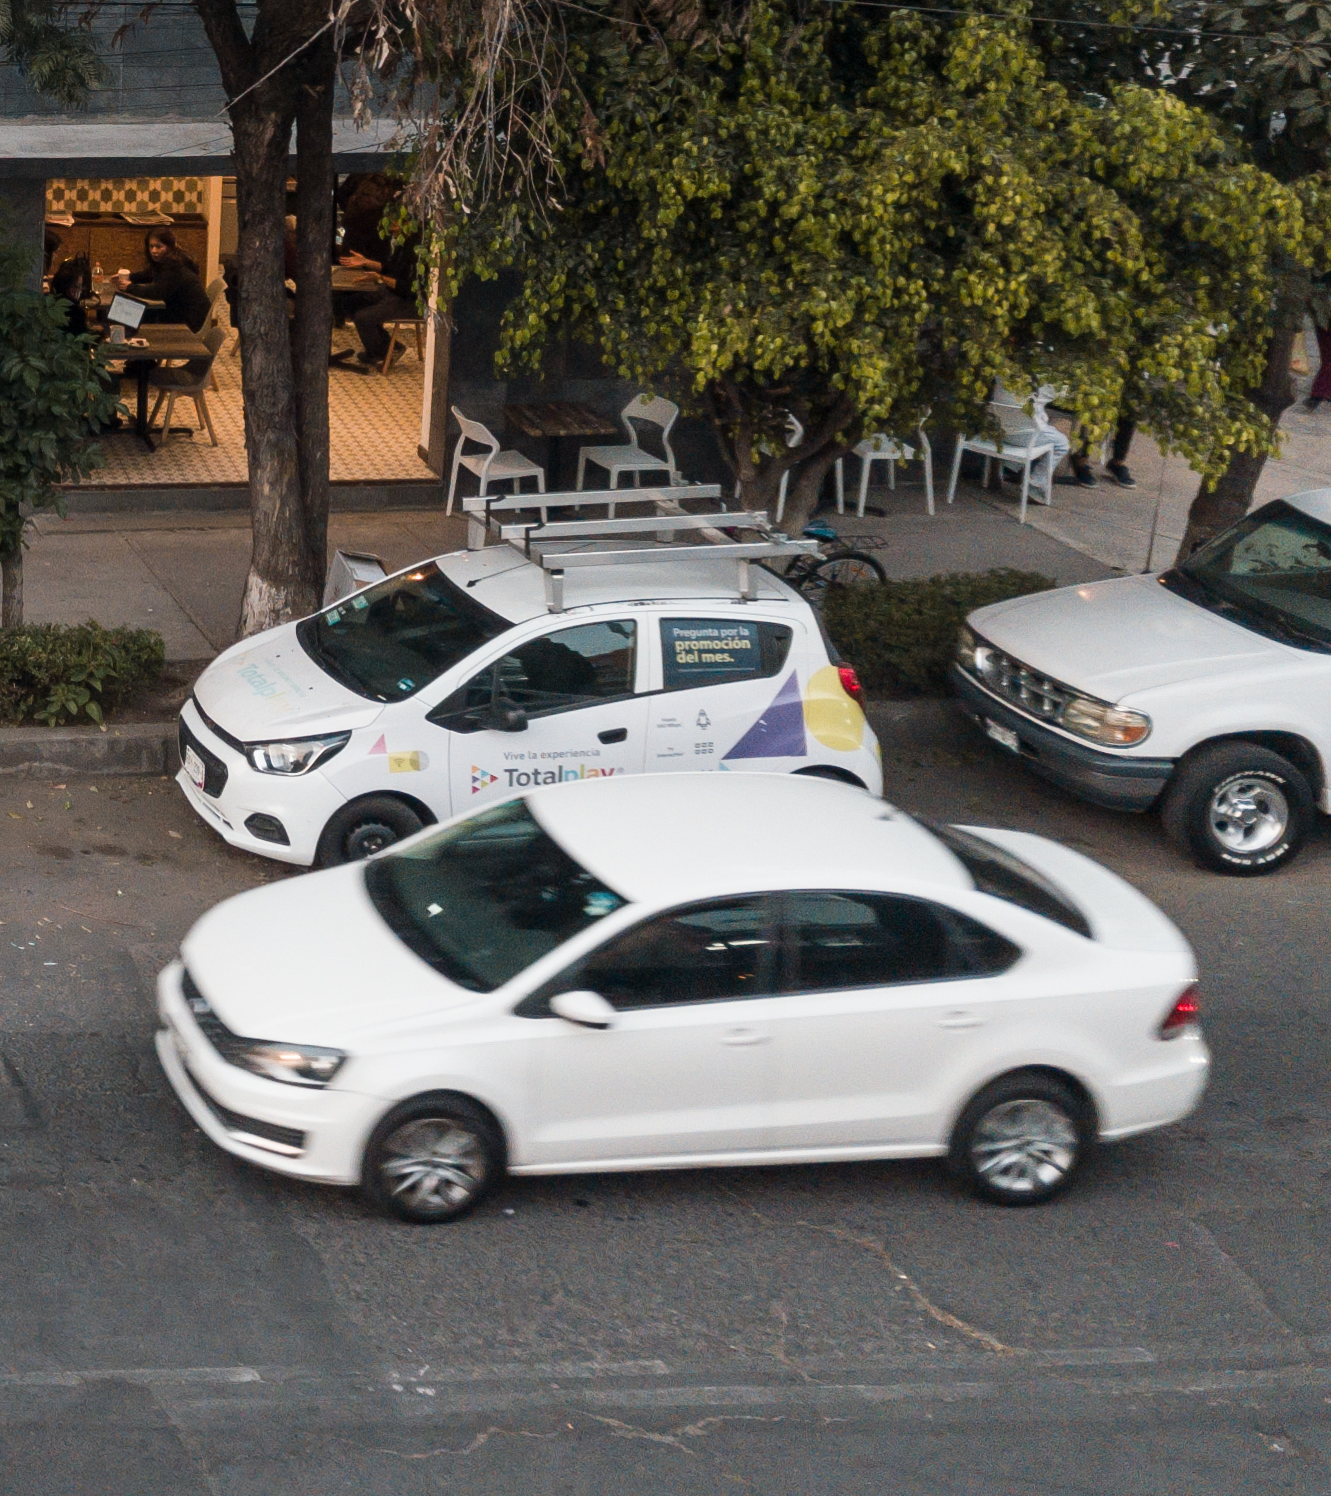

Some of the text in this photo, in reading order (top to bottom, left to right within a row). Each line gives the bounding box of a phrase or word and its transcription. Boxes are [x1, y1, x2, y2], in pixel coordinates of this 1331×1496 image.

[672, 626, 750, 639] Pregunta por la
[674, 636, 751, 652] promoción
[676, 650, 735, 663] del mes.
[503, 748, 601, 761] Vive la experiencia
